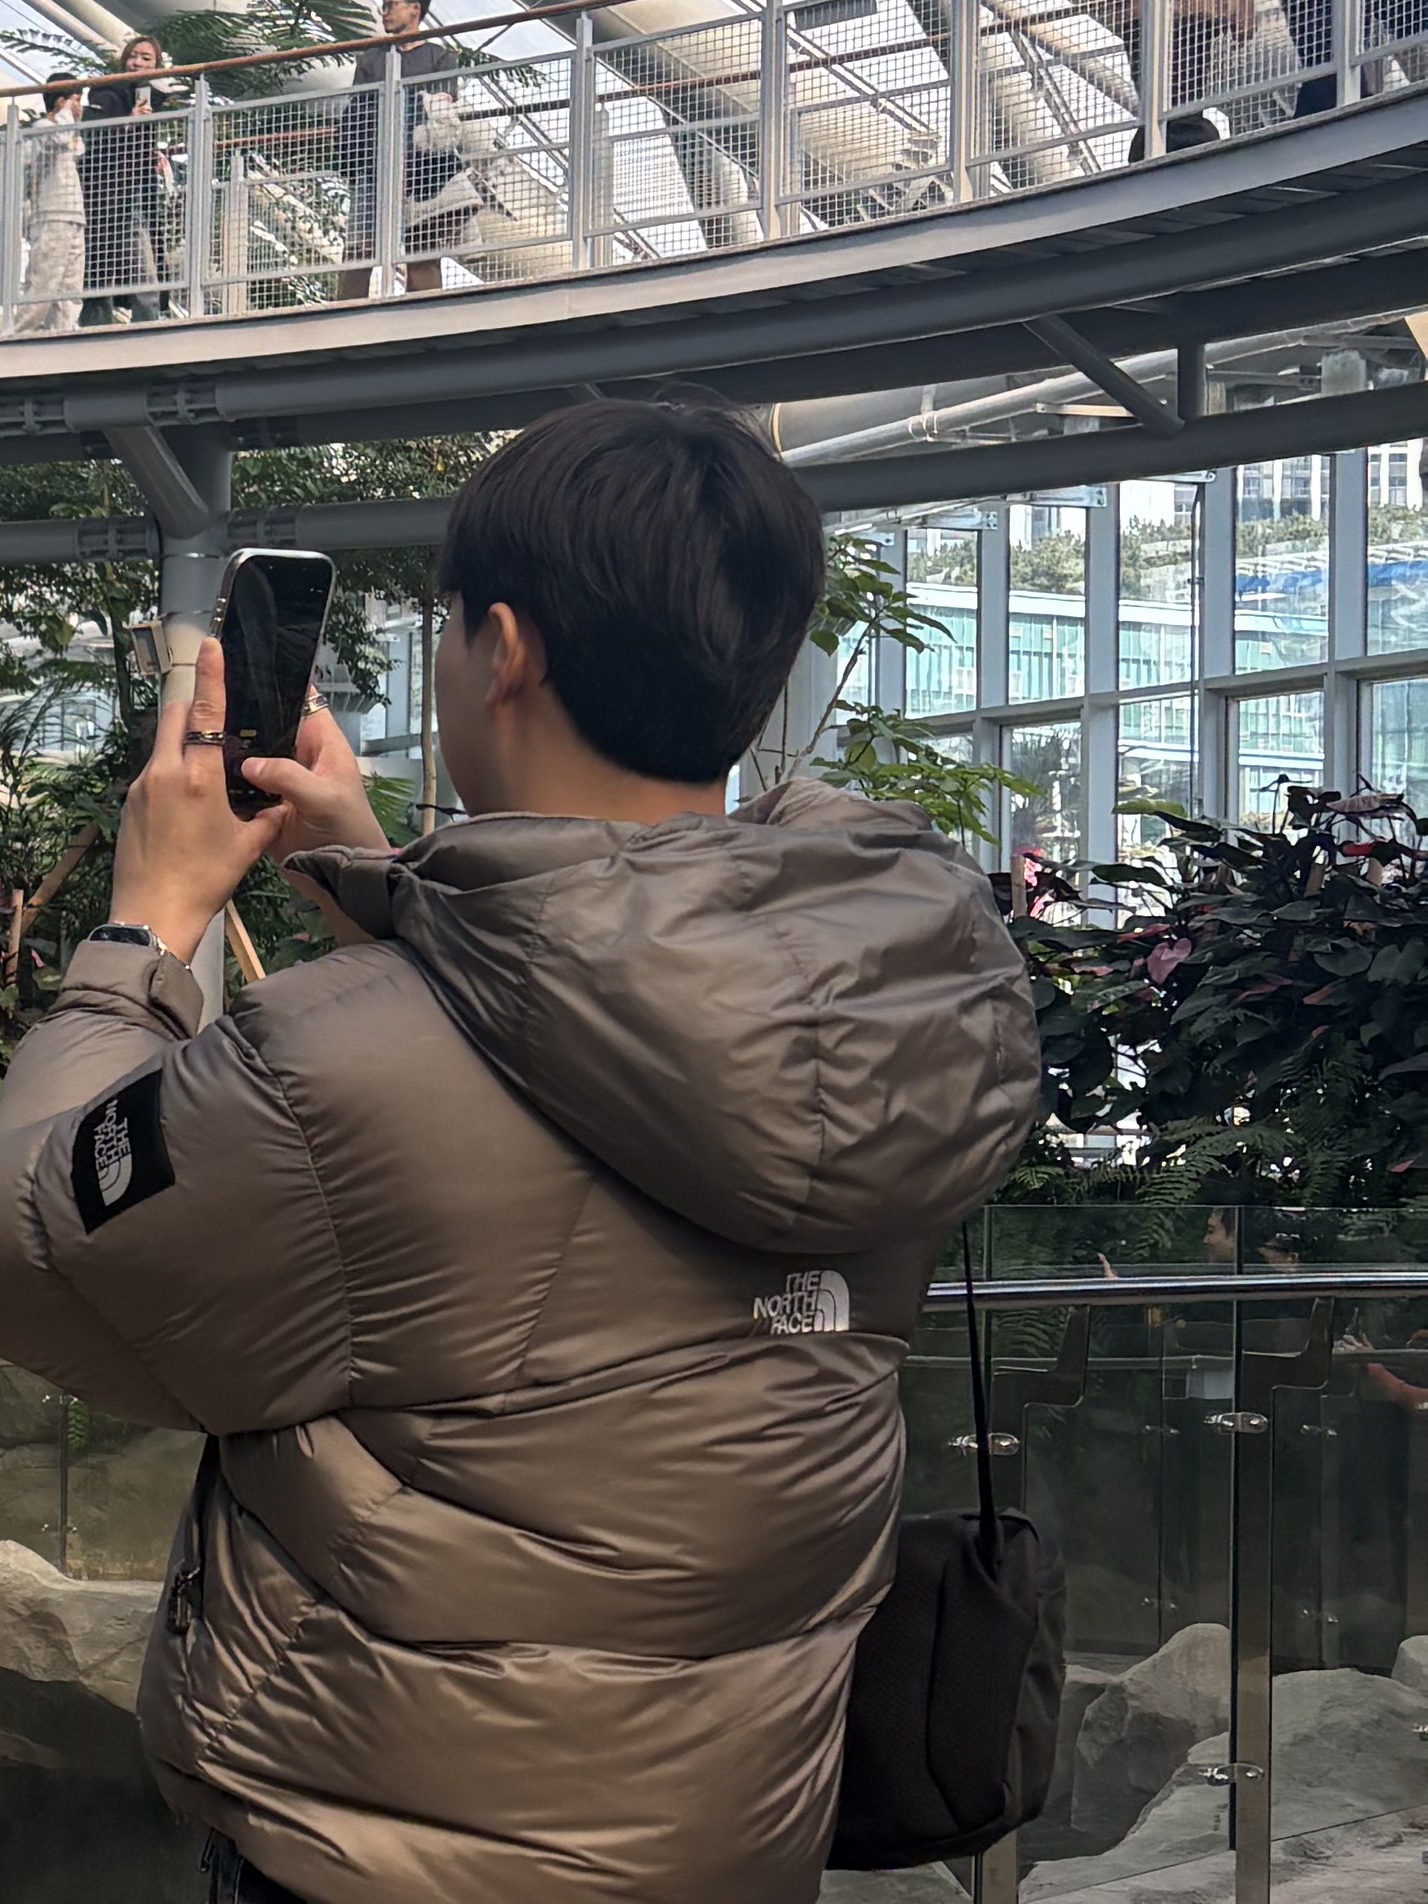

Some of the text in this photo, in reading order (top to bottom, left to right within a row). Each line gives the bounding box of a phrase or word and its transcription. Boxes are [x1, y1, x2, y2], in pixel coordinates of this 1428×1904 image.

[116, 1117, 131, 1154] THE
[786, 1270, 821, 1293] THE
[753, 1290, 817, 1319] NORTH
[770, 1311, 814, 1335] FACE
